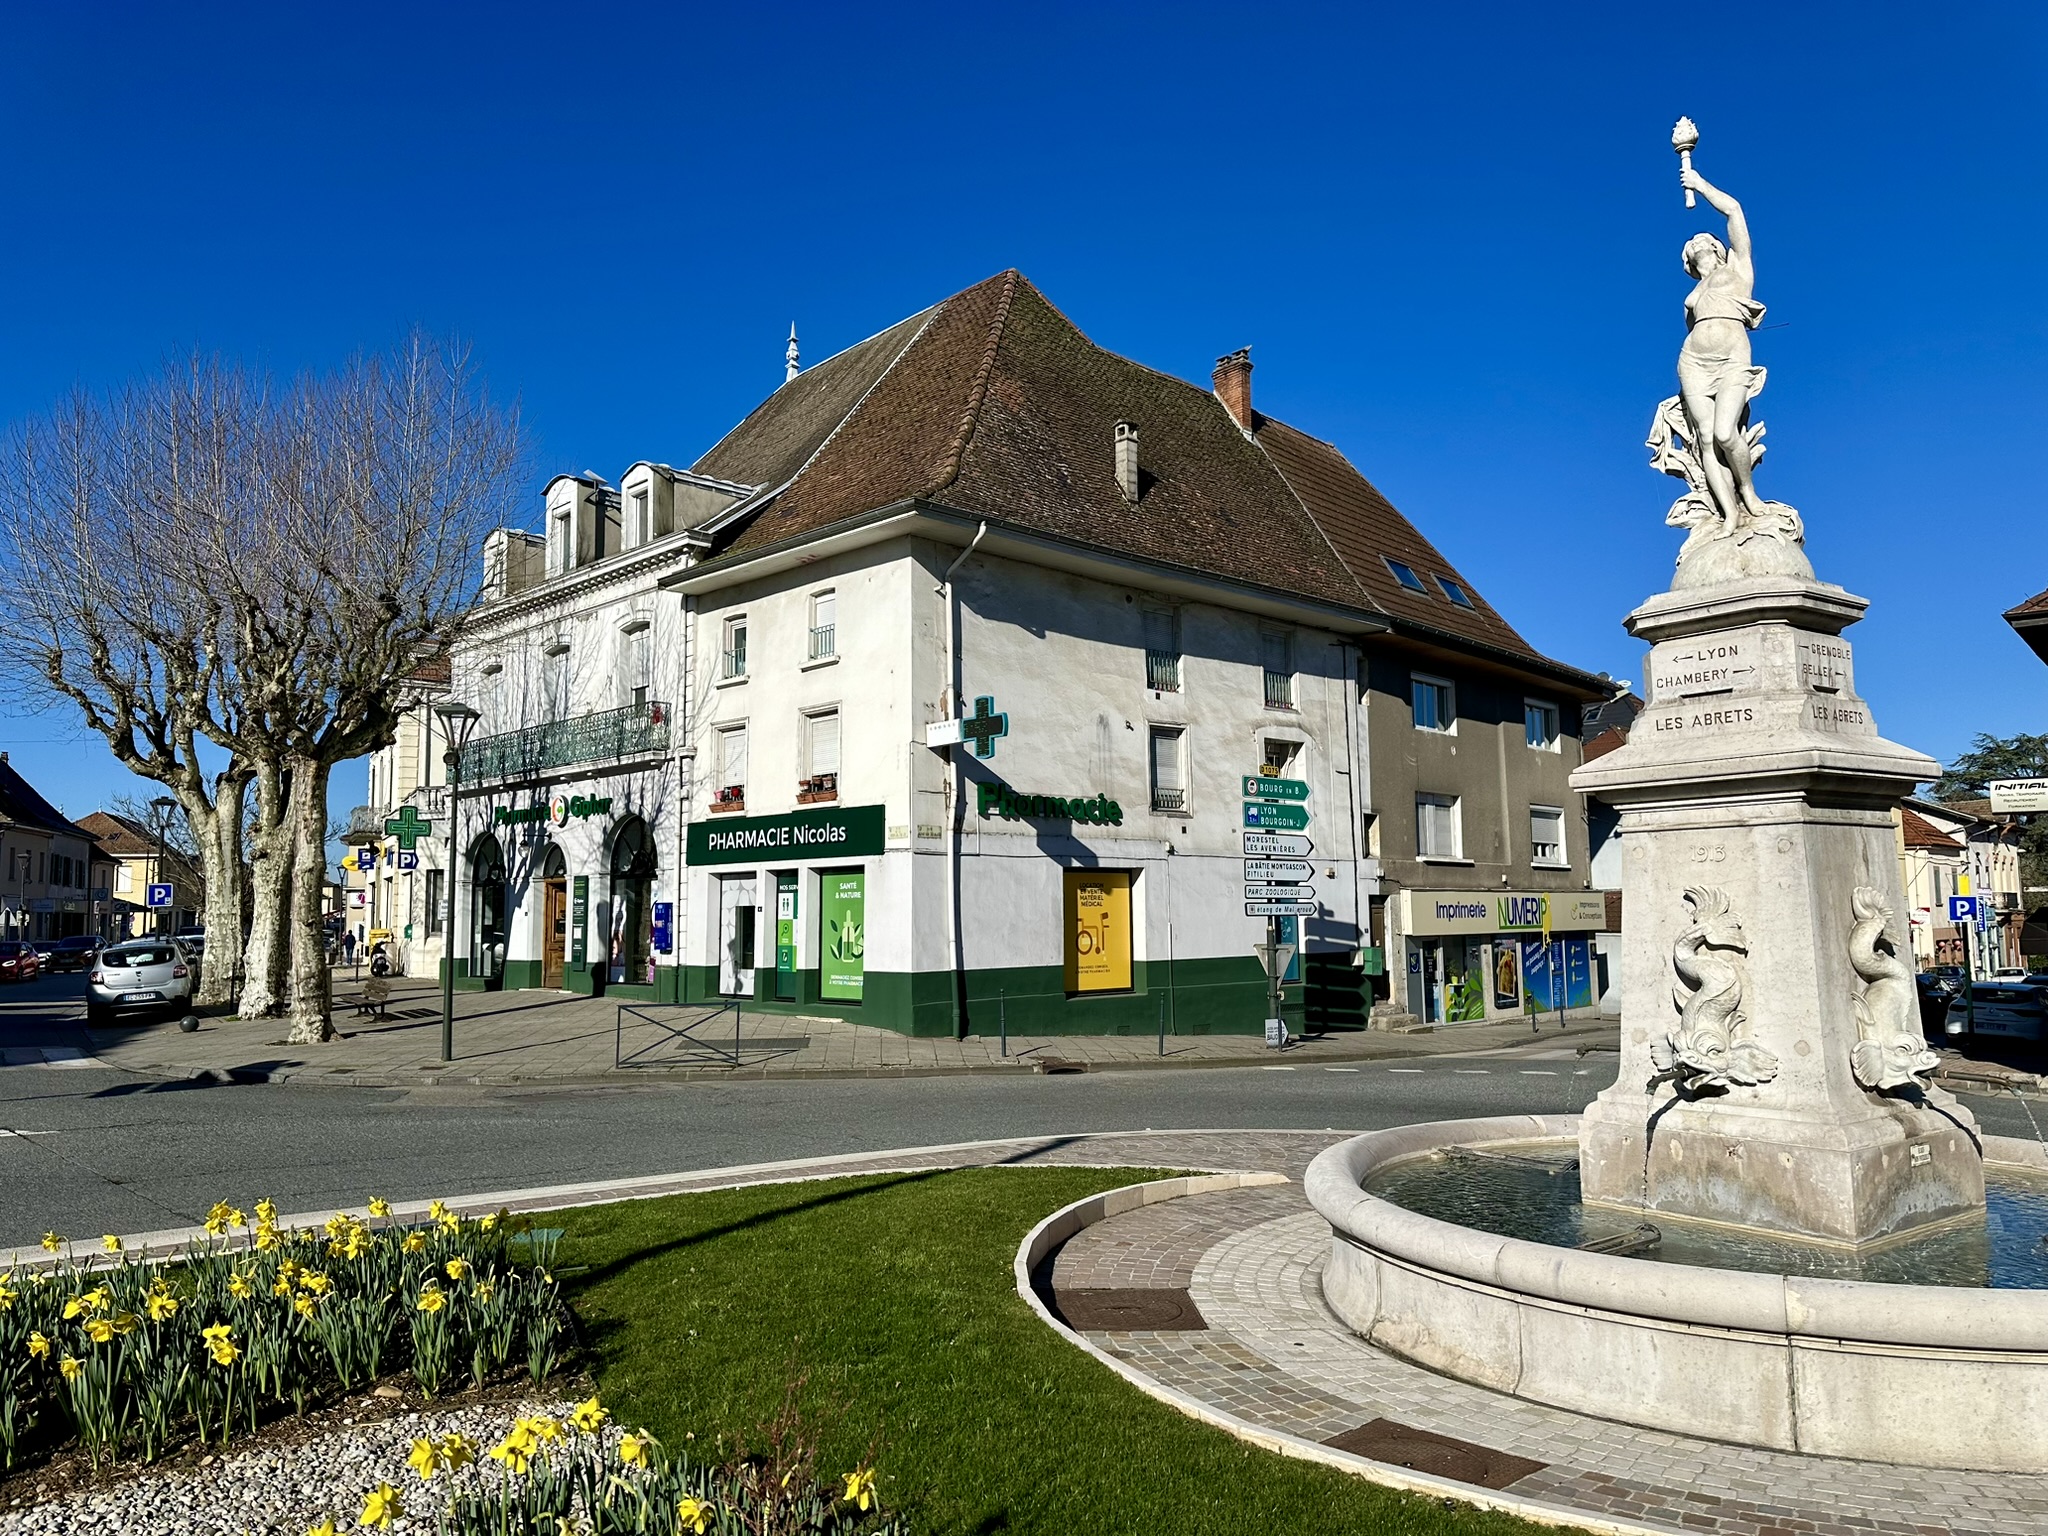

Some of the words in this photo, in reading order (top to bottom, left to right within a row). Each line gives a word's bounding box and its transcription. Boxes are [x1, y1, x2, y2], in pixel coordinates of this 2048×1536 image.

[1698, 645, 1738, 661] LYON
[1811, 643, 1851, 660] GRENOBLE
[1656, 668, 1729, 689] CHAMBERY
[1656, 717, 1683, 731] LES
[1692, 708, 1753, 728] ABRETS
[1812, 704, 1828, 719] LES
[1833, 709, 1863, 725] ABRETS
[1260, 783, 1283, 793] BOURG
[1995, 782, 2048, 791] INITIAL
[570, 793, 612, 821] Giphar
[977, 781, 1123, 822] Pharmacie
[1260, 806, 1277, 815] LYON
[709, 827, 790, 850] PHARMACIE
[794, 822, 846, 844] Nicolas
[1246, 836, 1279, 844] MORESTEL
[1261, 845, 1296, 853] AVENIÈRES
[1690, 845, 1726, 862] 1913
[401, 854, 411, 867] P
[1255, 861, 1270, 870] BÂTIE
[839, 881, 857, 890] SANTÉ
[154, 889, 166, 902] P
[1257, 906, 1273, 914] étang
[1284, 905, 1312, 913] Maleroud
[1436, 901, 1487, 921] Imprimerie
[1956, 900, 1970, 917] P
